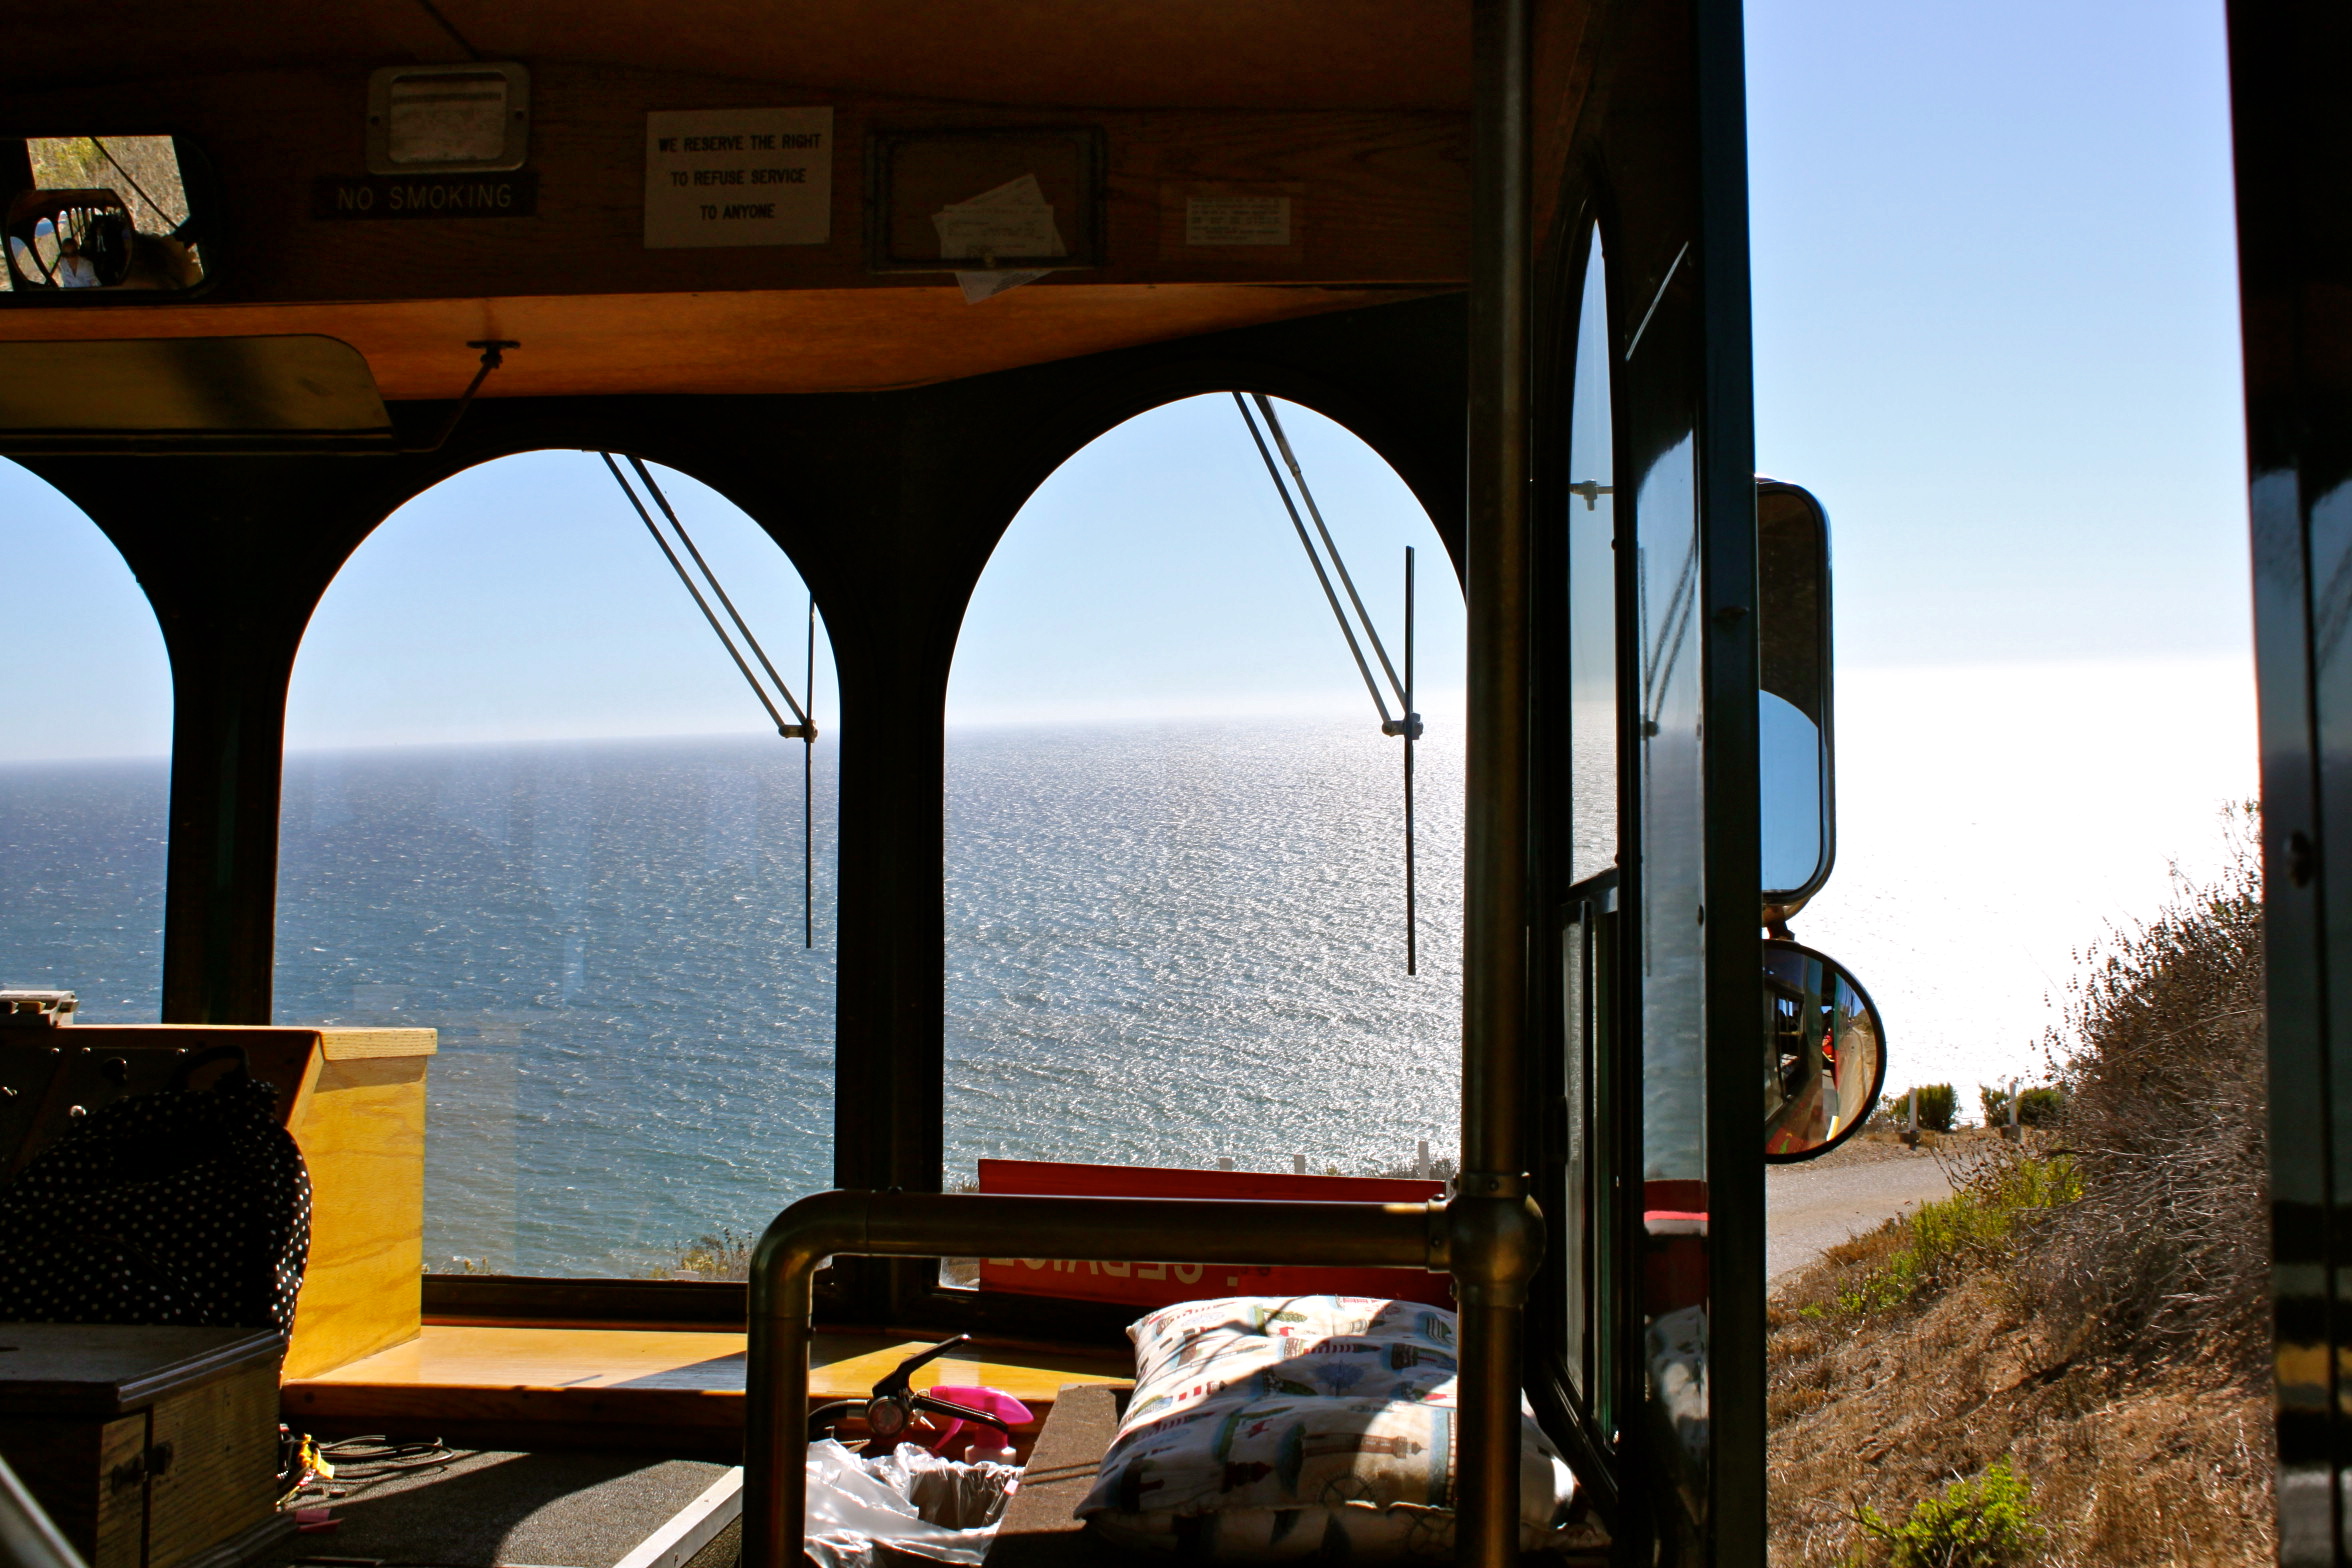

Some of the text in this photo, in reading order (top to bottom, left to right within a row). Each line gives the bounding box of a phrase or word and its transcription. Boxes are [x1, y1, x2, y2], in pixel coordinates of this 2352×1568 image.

[658, 133, 822, 152] WE RESERVE THE RIGHT
[671, 168, 806, 186] TO REFUSE SERVICE
[337, 184, 513, 211] NO SMOKING
[700, 203, 776, 220] TO ANYONE
